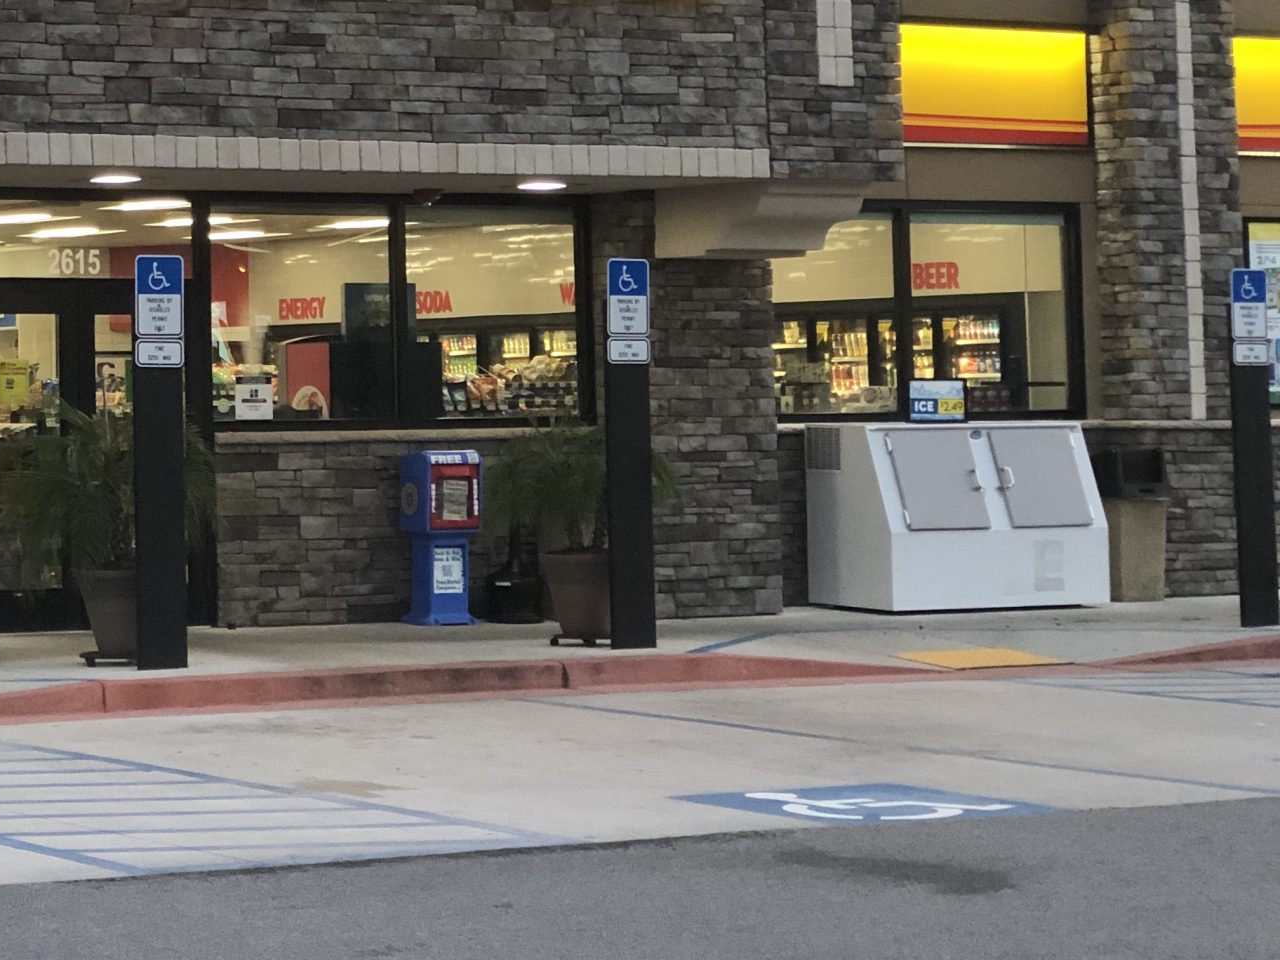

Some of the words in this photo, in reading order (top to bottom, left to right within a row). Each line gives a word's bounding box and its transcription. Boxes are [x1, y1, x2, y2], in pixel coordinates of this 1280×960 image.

[47, 248, 101, 275] 2615
[912, 261, 960, 289] BEER
[278, 296, 326, 320] ENERGY
[416, 290, 453, 314] SODA
[914, 401, 935, 412] ICE
[431, 455, 463, 464] FREE
